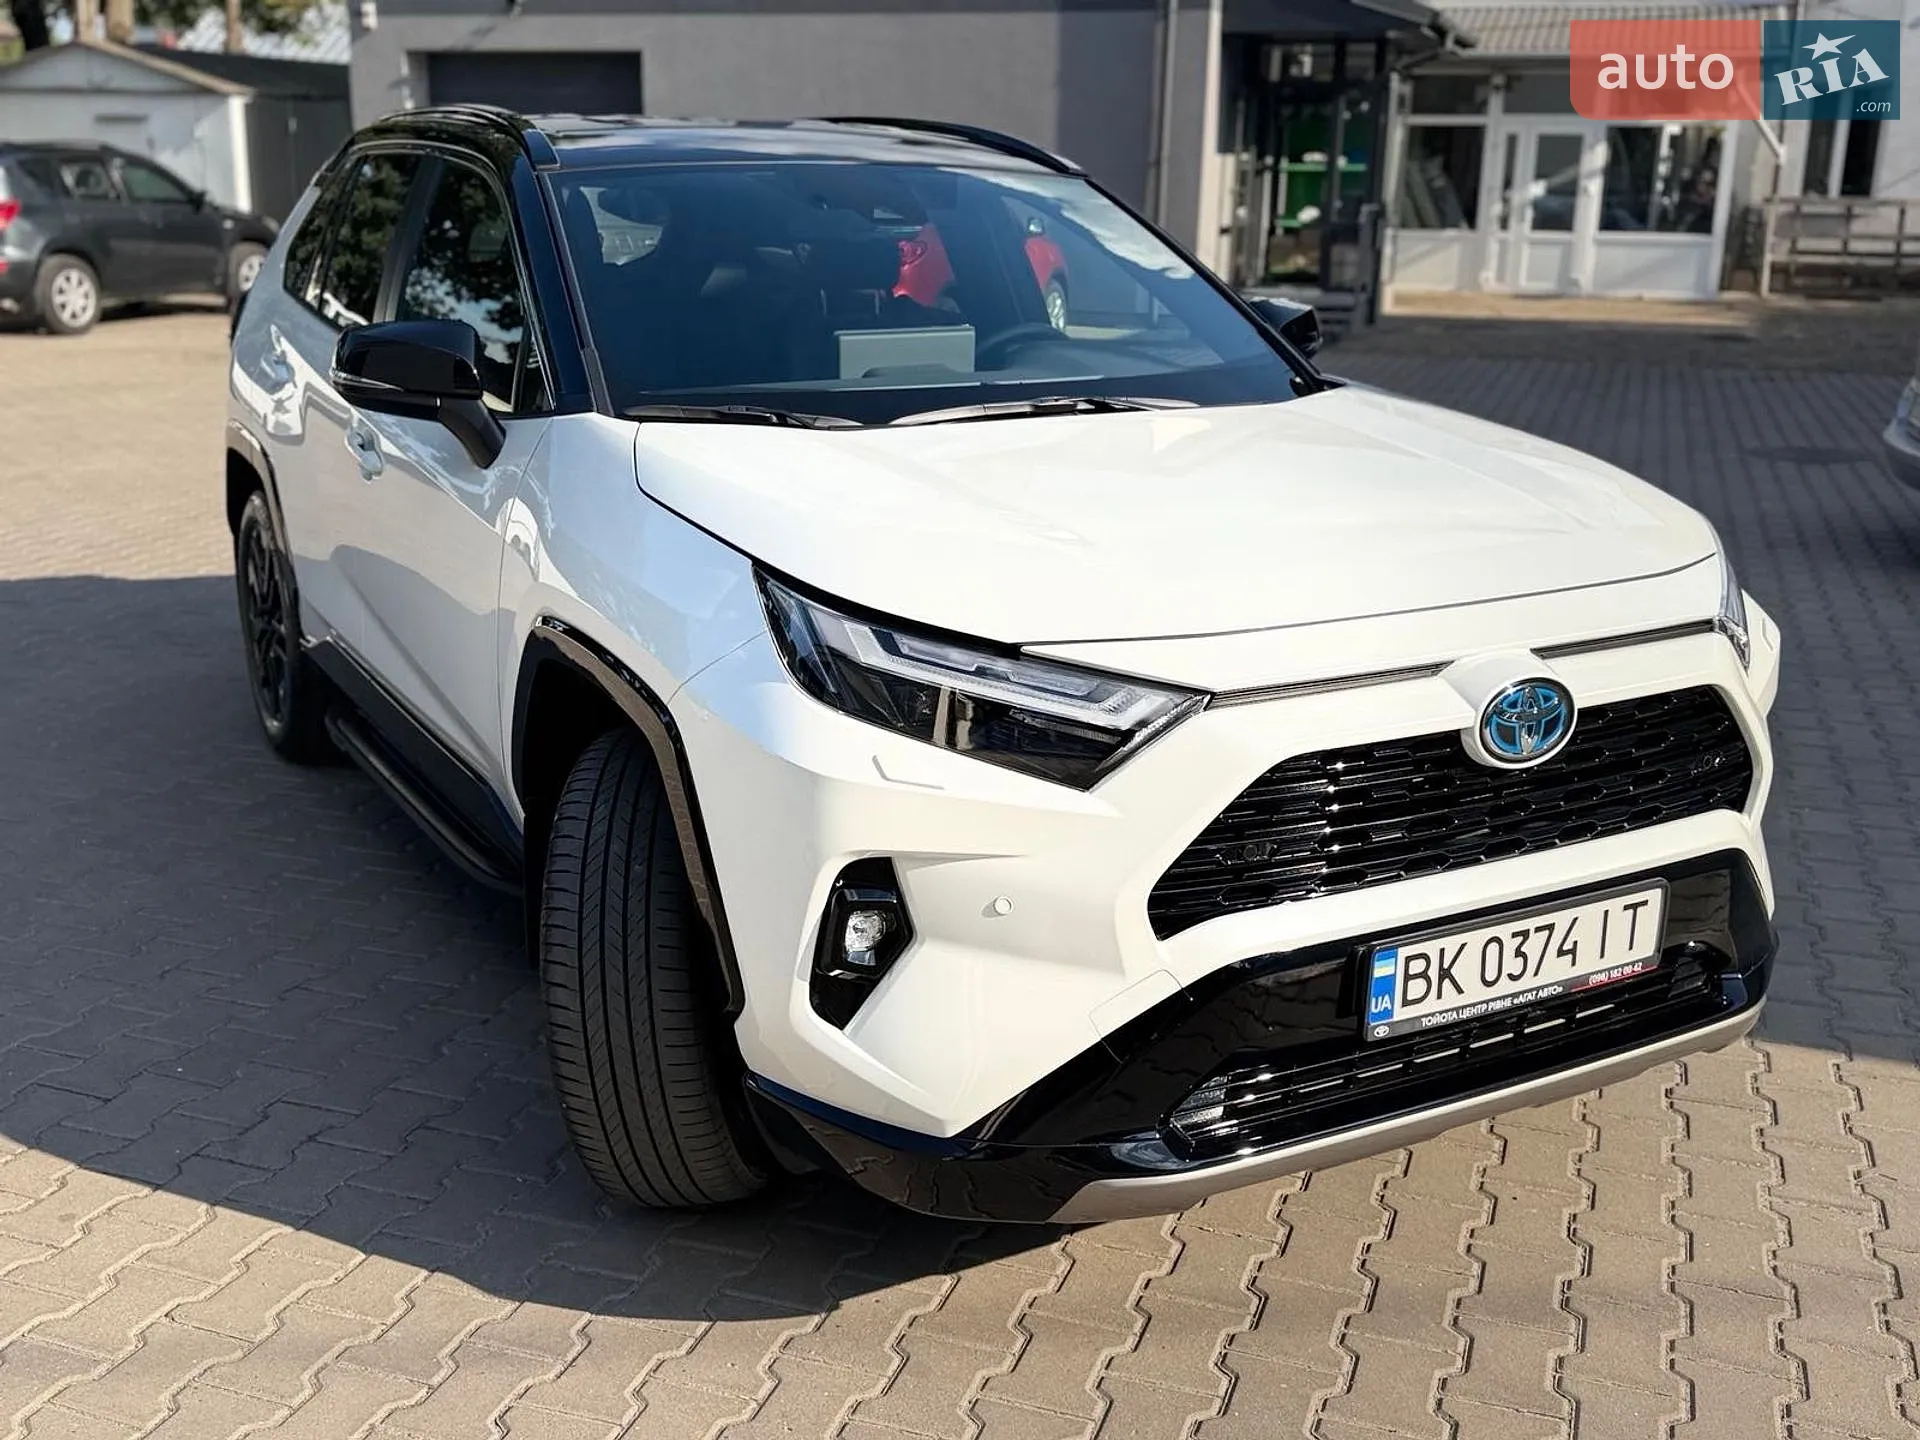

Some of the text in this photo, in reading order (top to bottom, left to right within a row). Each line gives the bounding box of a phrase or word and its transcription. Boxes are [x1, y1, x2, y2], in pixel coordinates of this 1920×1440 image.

[1401, 899, 1649, 1008] BK 0374 IT
[1371, 993, 1392, 1014] UA
[1421, 1010, 1458, 1028] ТОЙОТА
[1459, 1003, 1488, 1019] ЦЕНТР
[1488, 997, 1513, 1014] РІВНЕ
